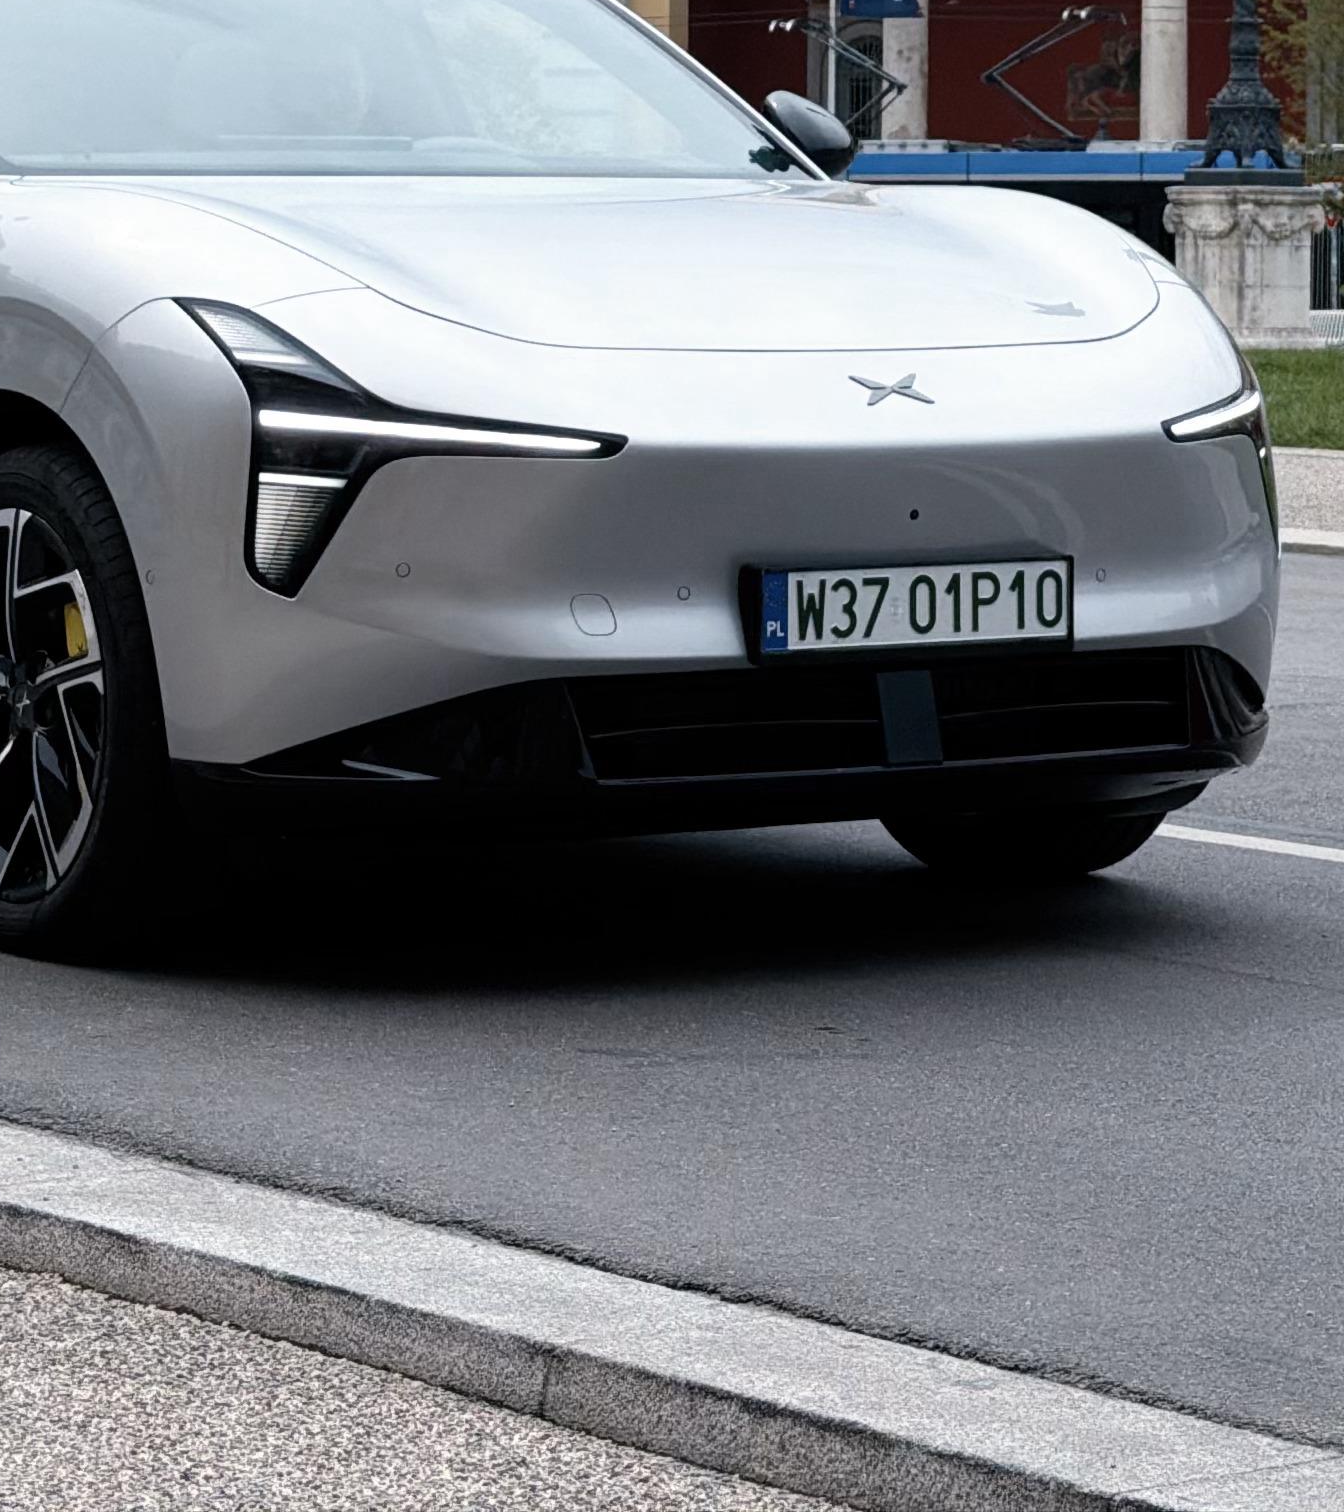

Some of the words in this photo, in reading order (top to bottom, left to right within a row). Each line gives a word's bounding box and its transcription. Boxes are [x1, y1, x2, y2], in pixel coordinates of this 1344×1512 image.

[796, 576, 890, 641] W37
[909, 569, 1063, 634] 01P10
[767, 621, 785, 637] PL
